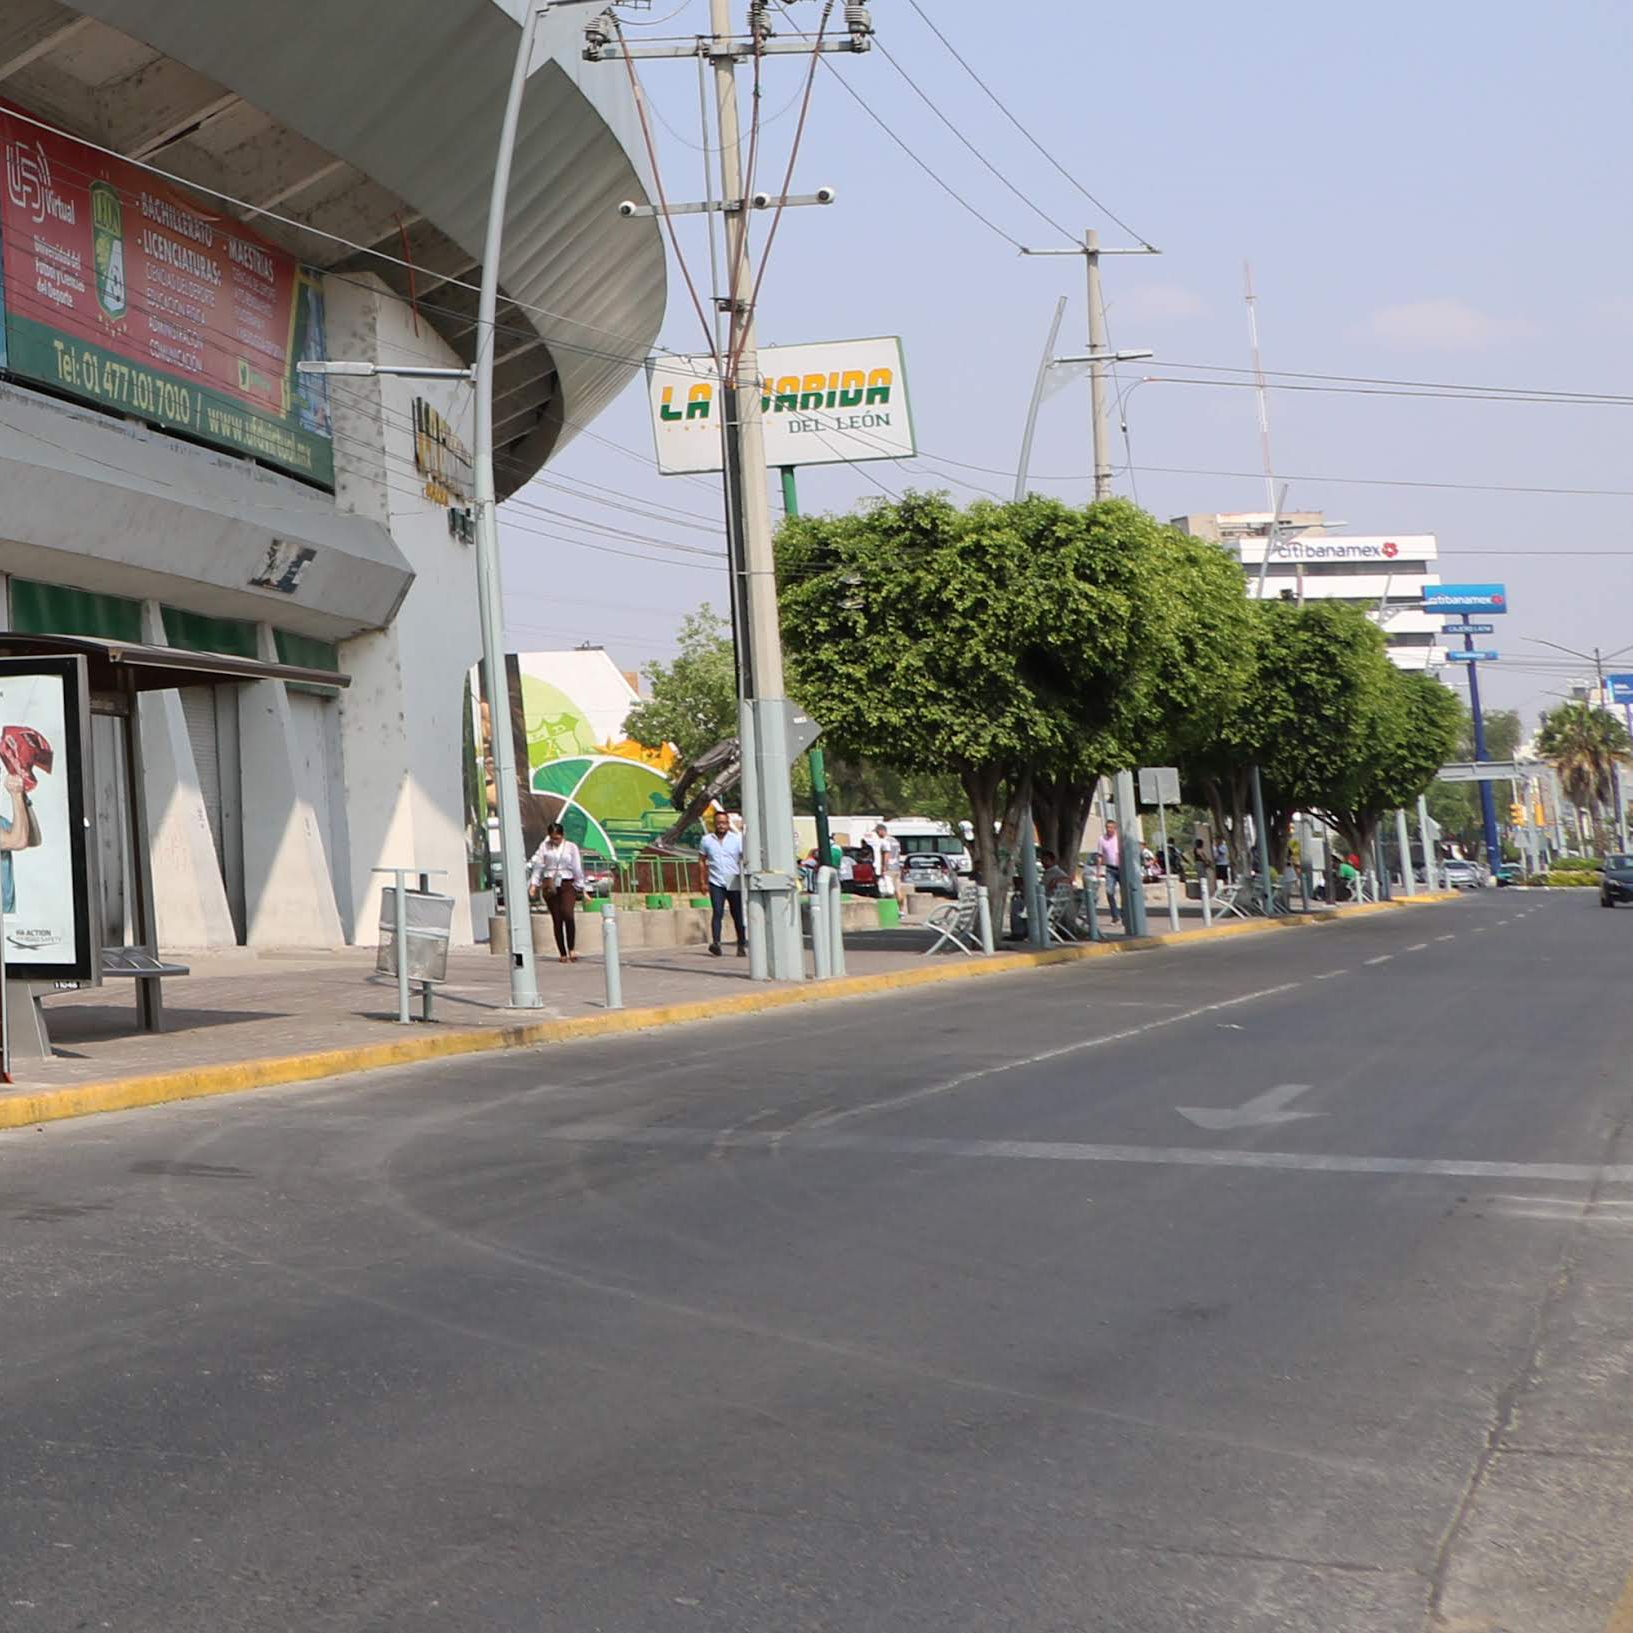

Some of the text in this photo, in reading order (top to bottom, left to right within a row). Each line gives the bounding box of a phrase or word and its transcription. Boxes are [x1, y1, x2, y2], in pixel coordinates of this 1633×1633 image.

[53, 340, 80, 386] Tel:
[84, 351, 101, 394] 01
[103, 361, 128, 403] 477
[660, 383, 713, 422] LA
[788, 410, 892, 434] DEL LEÓN
